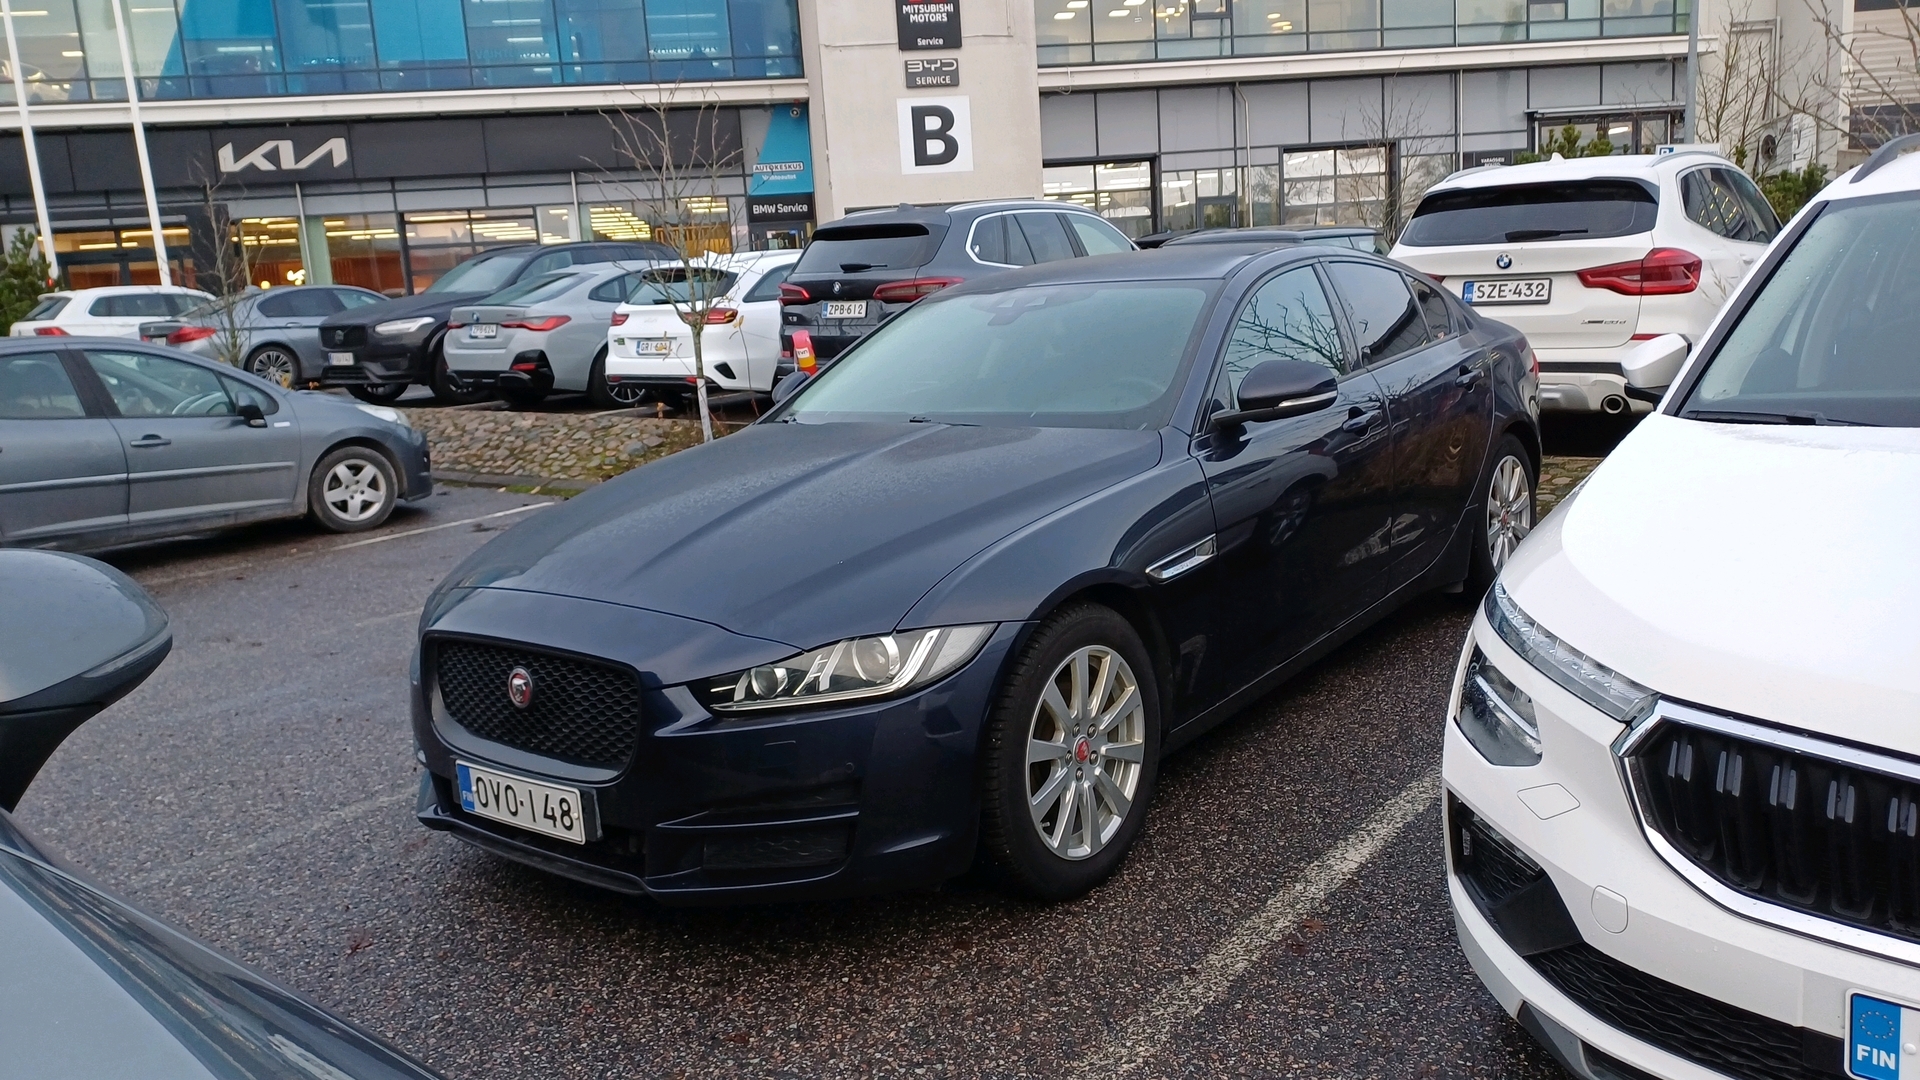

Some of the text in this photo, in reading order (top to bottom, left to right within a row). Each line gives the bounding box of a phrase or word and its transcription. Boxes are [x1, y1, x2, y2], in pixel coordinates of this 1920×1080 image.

[902, 3, 954, 14] MITSUBISHI
[909, 13, 948, 23] MOTORS
[917, 37, 944, 46] Service
[907, 59, 957, 72] BYD
[915, 75, 951, 85] SERVICE
[910, 104, 959, 167] B
[754, 163, 802, 171] AUTOKESKUS
[752, 203, 808, 214] BMW Service
[1476, 282, 1546, 299] SZE-432
[828, 303, 864, 315] ZPB-612
[475, 776, 574, 832] OVO-148
[1856, 1043, 1896, 1071] FIN
